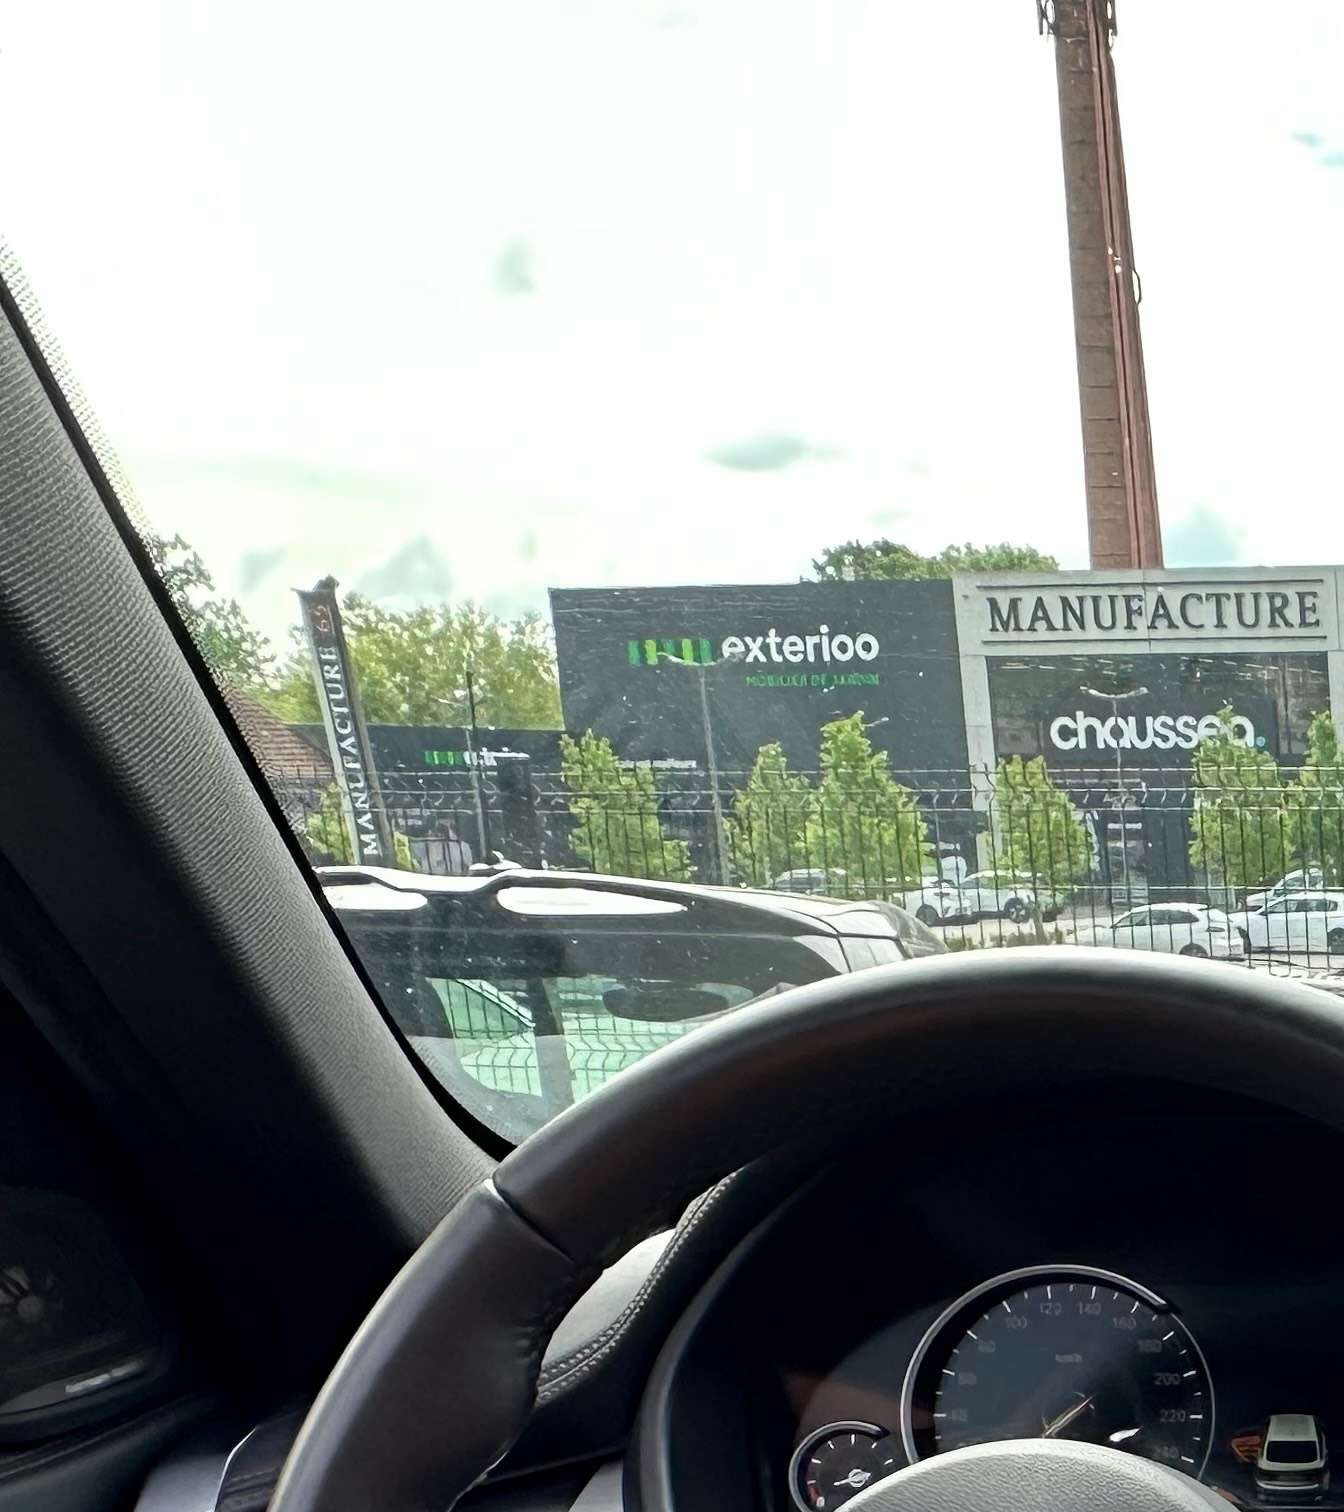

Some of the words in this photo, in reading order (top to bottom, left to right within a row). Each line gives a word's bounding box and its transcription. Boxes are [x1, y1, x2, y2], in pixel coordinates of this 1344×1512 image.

[986, 590, 1321, 632] MANUFACTURE
[720, 624, 881, 663] exterioo
[319, 645, 380, 857] MANUFACTURE
